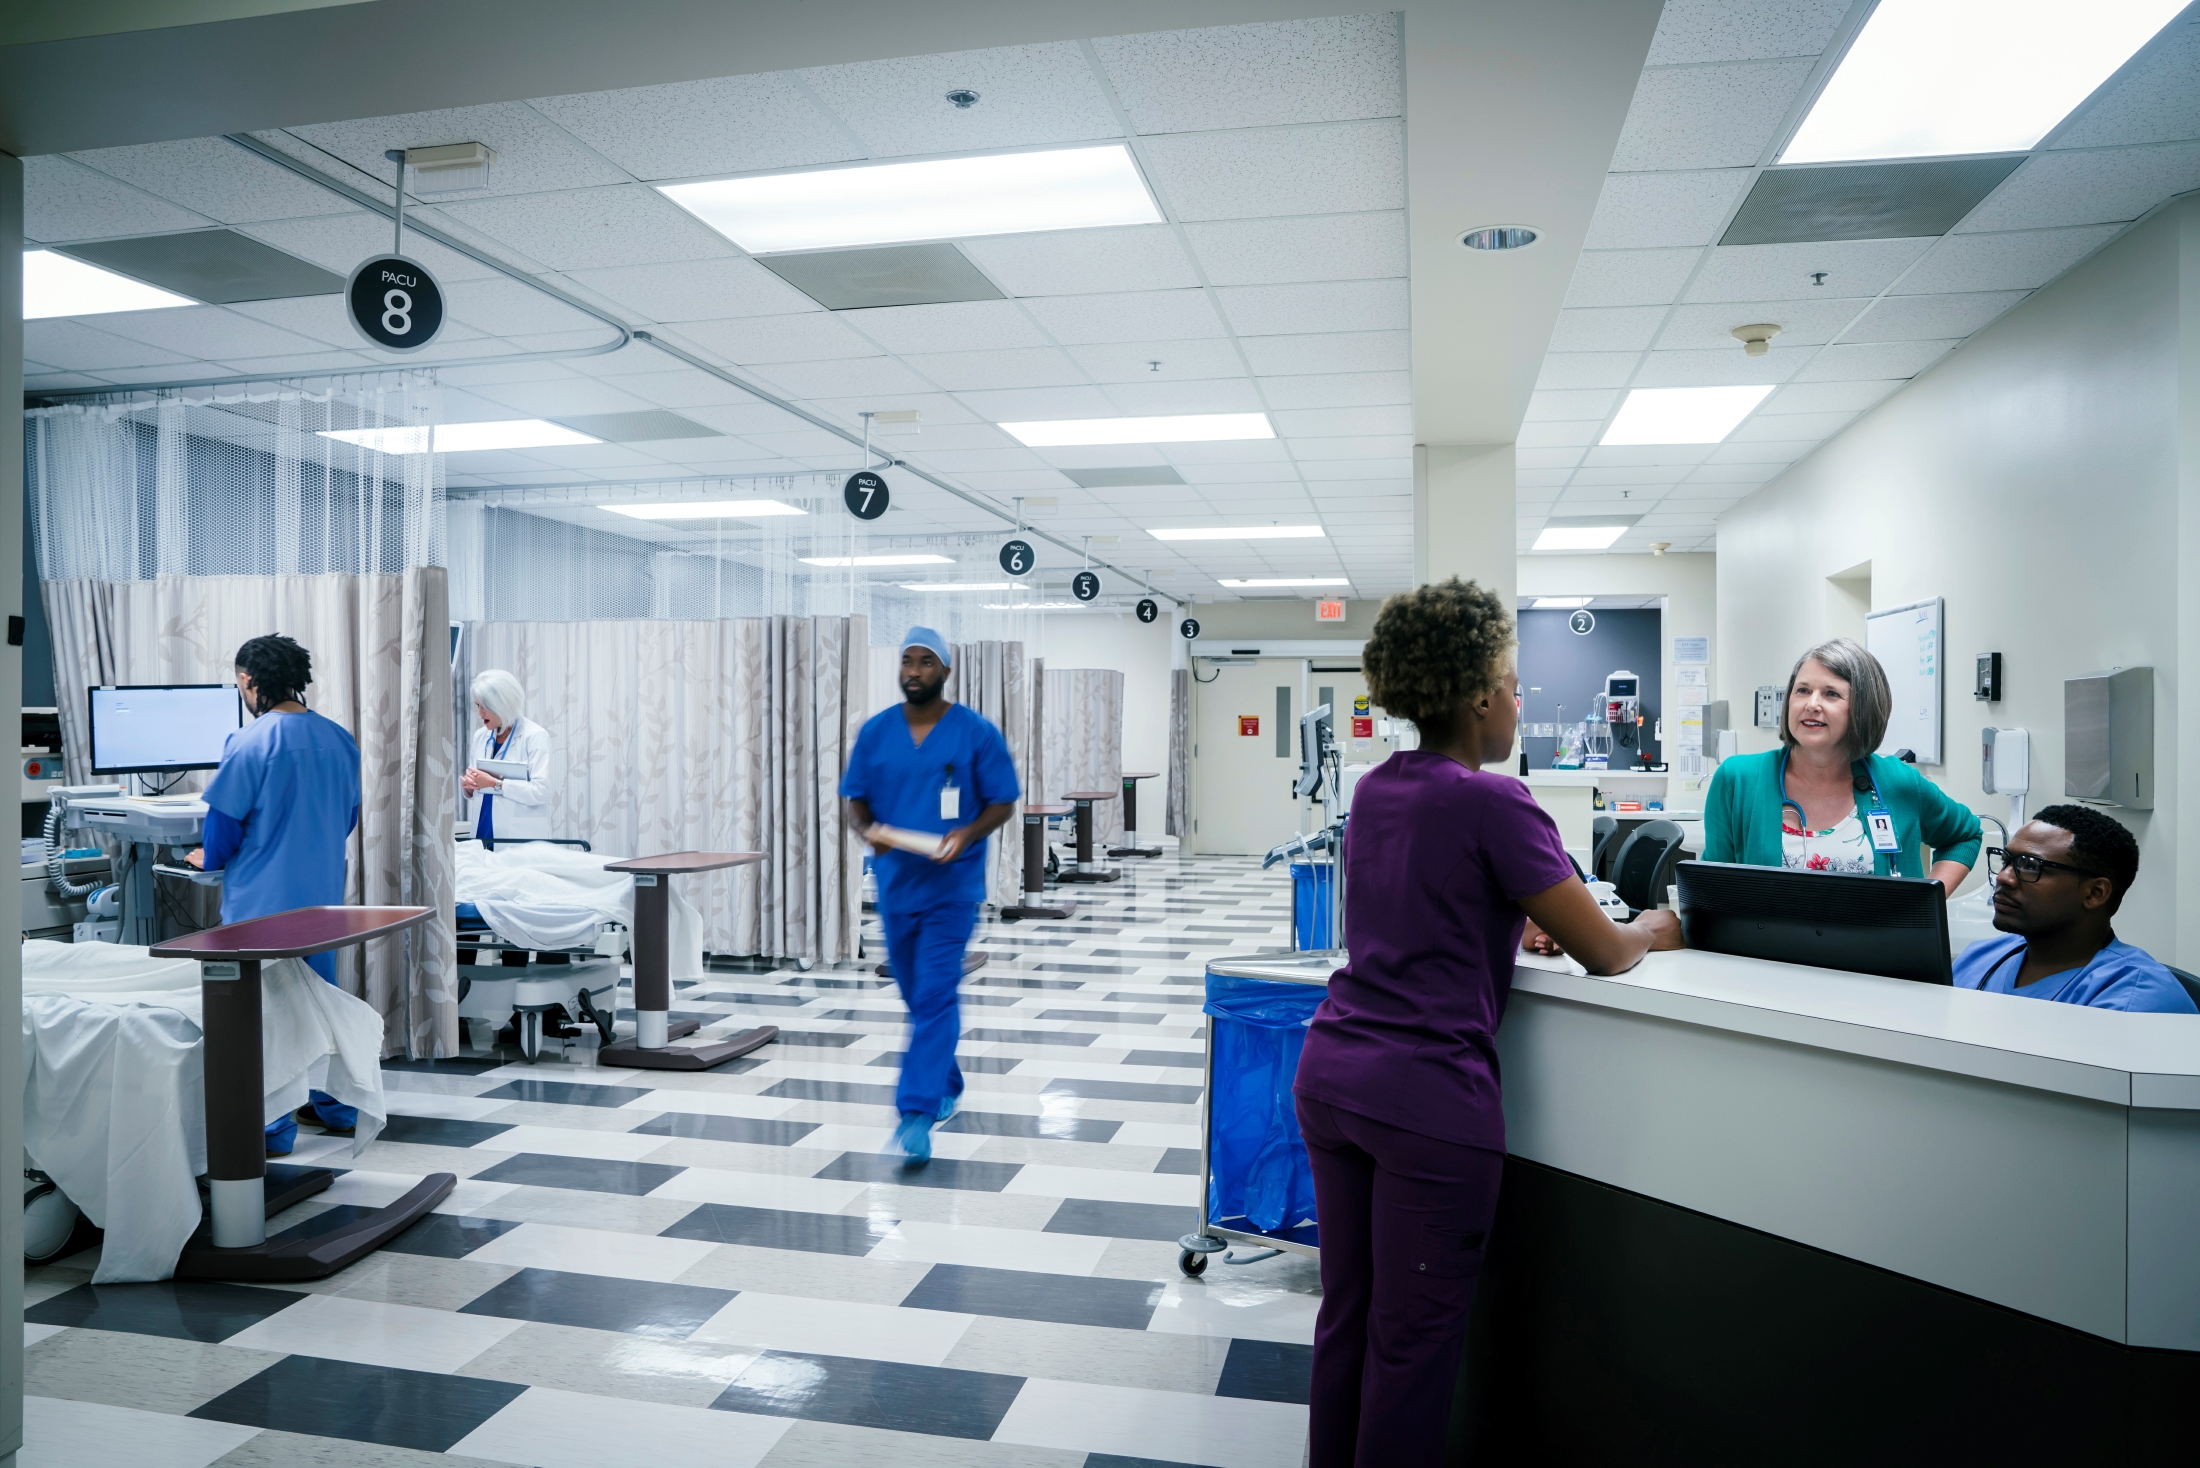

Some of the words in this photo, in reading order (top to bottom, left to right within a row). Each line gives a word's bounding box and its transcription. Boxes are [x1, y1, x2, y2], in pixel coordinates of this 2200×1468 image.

[381, 270, 417, 288] PACU
[381, 289, 412, 335] 8
[858, 478, 877, 487] PACU
[859, 487, 875, 513] 7
[1010, 551, 1023, 571] 6
[1081, 581, 1091, 598] 5
[1143, 606, 1152, 620] 4
[1320, 601, 1343, 619] EXIT
[1186, 625, 1194, 637] 3
[1577, 618, 1586, 631] 2
